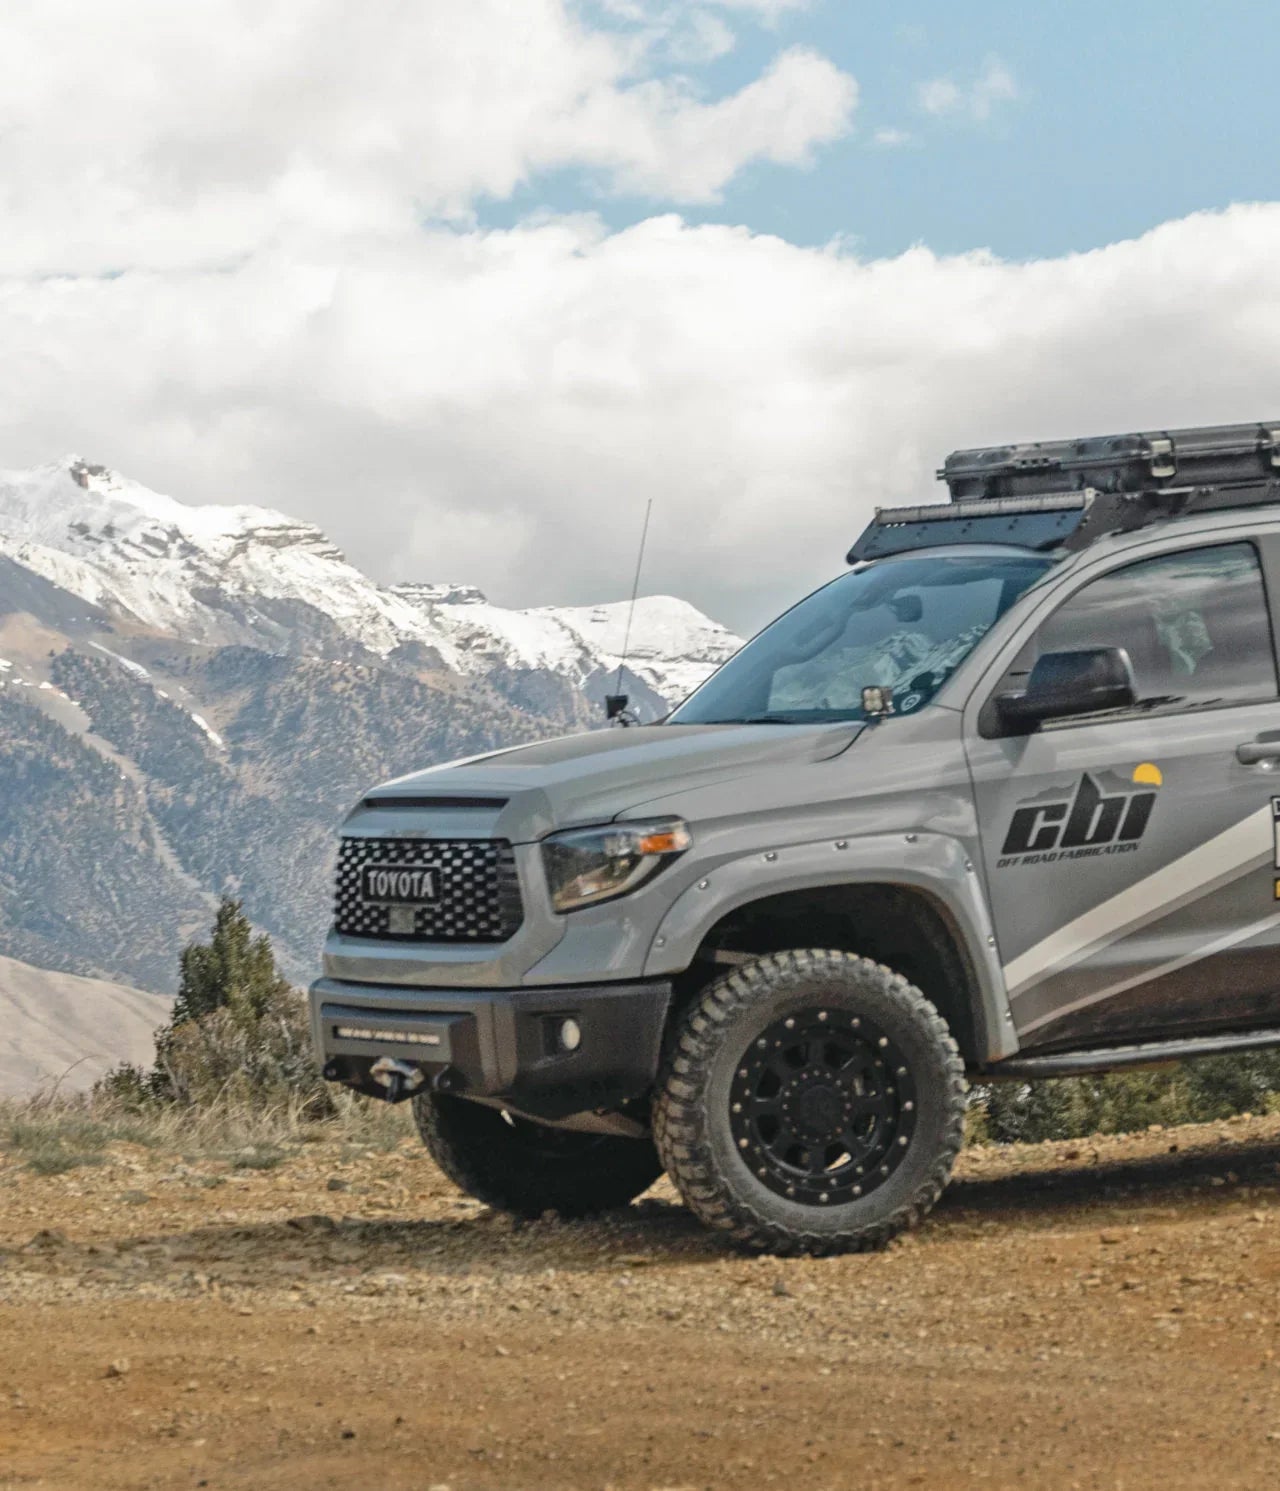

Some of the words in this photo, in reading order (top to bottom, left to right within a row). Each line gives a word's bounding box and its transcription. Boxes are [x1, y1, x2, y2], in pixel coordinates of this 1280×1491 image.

[996, 858, 1021, 869] OFF
[1021, 852, 1057, 865] ROAD
[1058, 842, 1141, 861] FABRICATION
[367, 870, 435, 897] TOYOTA
